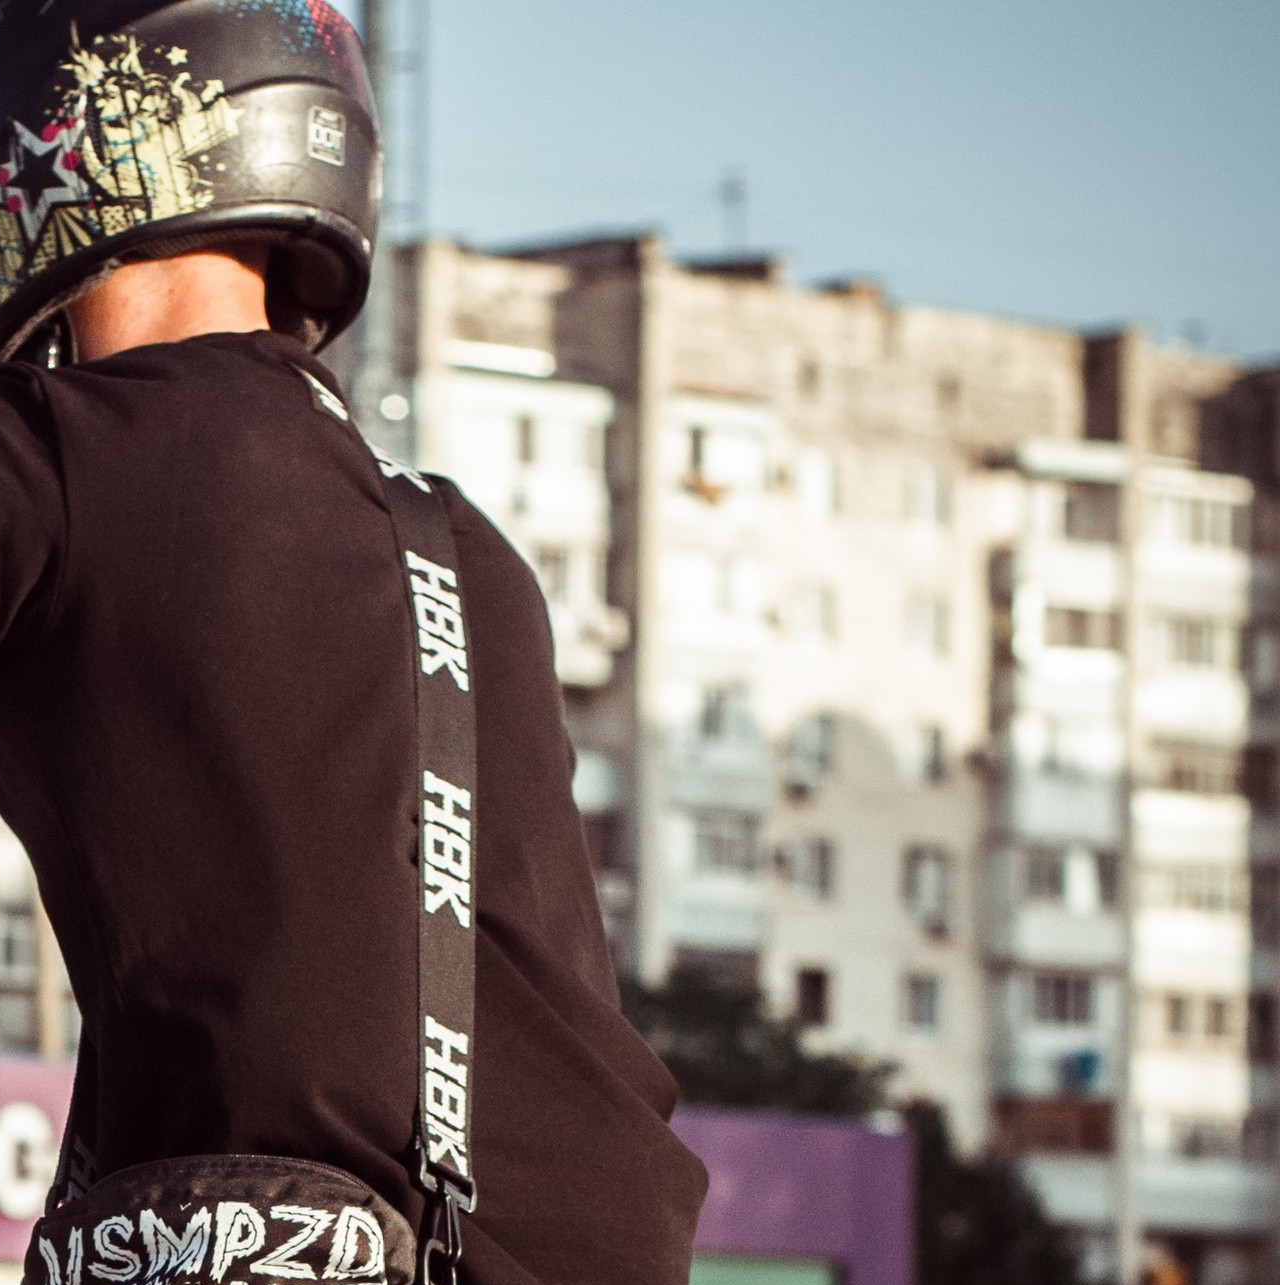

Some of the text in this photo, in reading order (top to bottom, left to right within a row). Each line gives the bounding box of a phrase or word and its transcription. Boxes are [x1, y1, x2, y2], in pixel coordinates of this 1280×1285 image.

[404, 550, 470, 692] HBK
[423, 770, 471, 928] HBK
[425, 1016, 468, 1178] HBK
